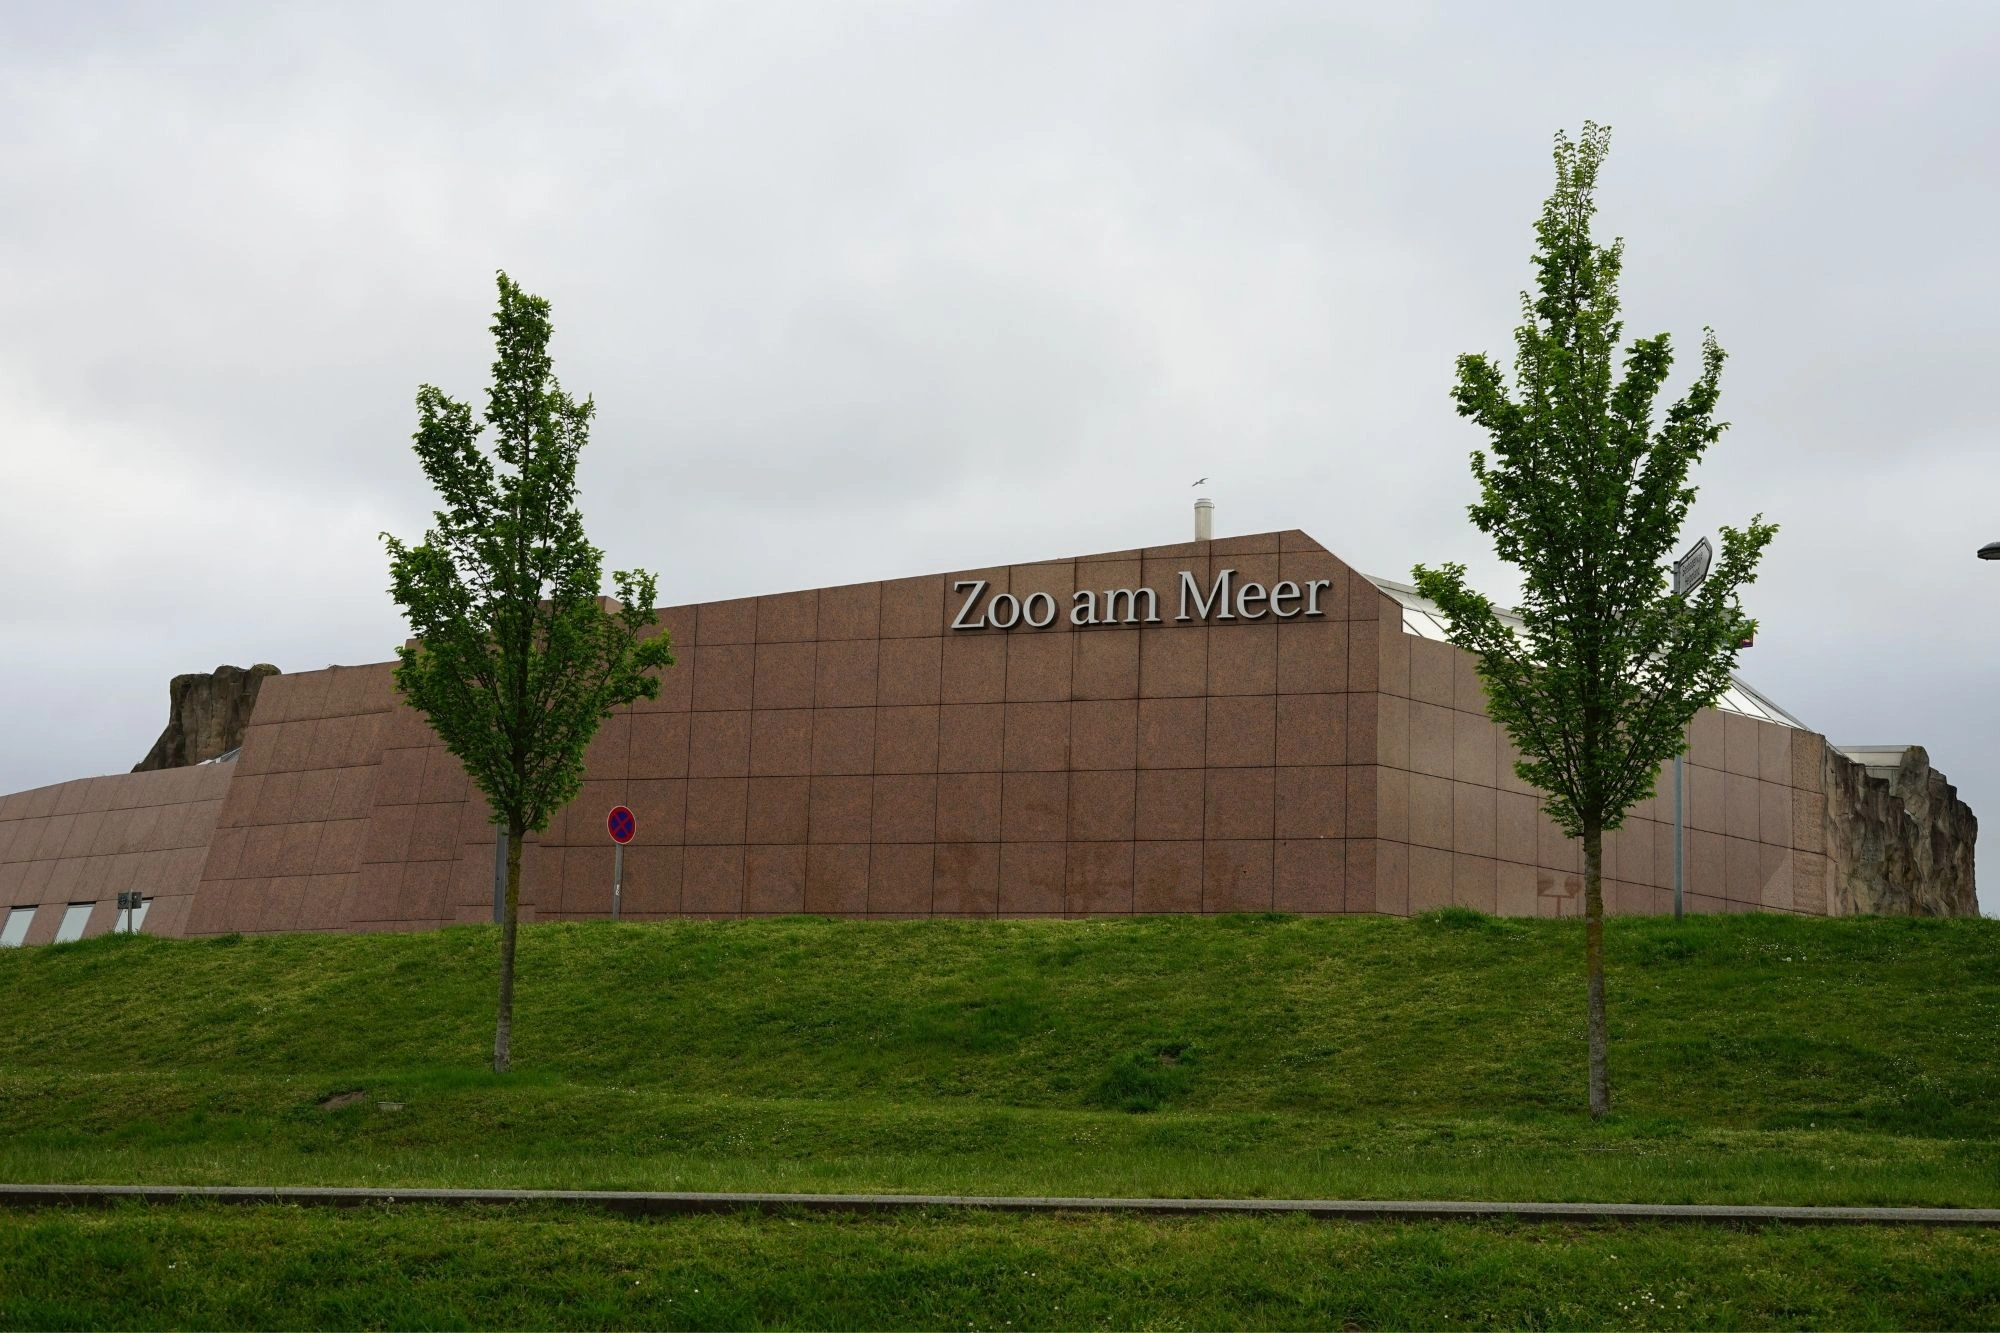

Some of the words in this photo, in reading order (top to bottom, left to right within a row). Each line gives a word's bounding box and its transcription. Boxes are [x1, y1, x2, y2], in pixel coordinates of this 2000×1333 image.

[951, 580, 1056, 629] Zoo
[1070, 587, 1161, 625] am
[1174, 568, 1330, 620] Meer
